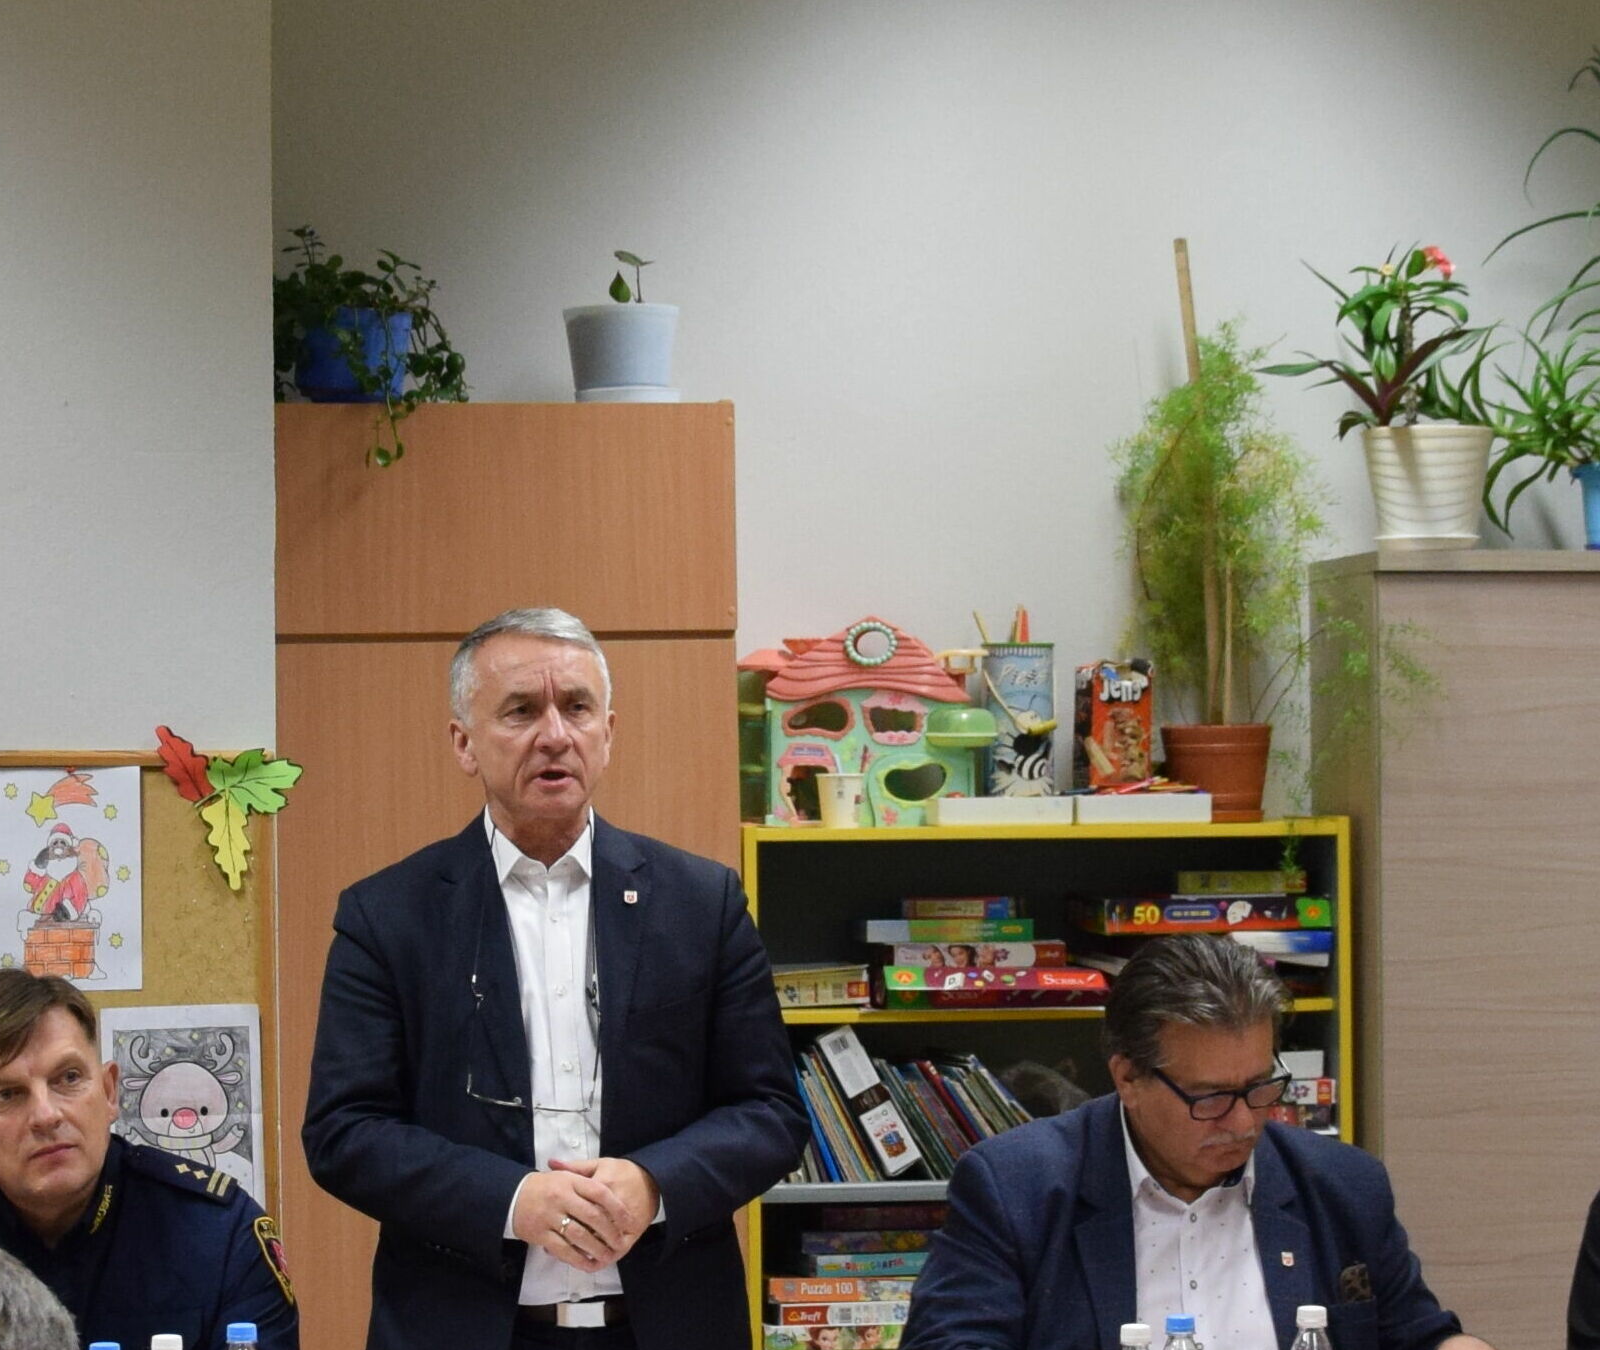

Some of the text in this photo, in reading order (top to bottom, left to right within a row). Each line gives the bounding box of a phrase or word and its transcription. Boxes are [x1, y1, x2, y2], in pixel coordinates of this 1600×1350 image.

[1133, 904, 1161, 926] 50
[800, 1281, 854, 1295] Puzzle 100
